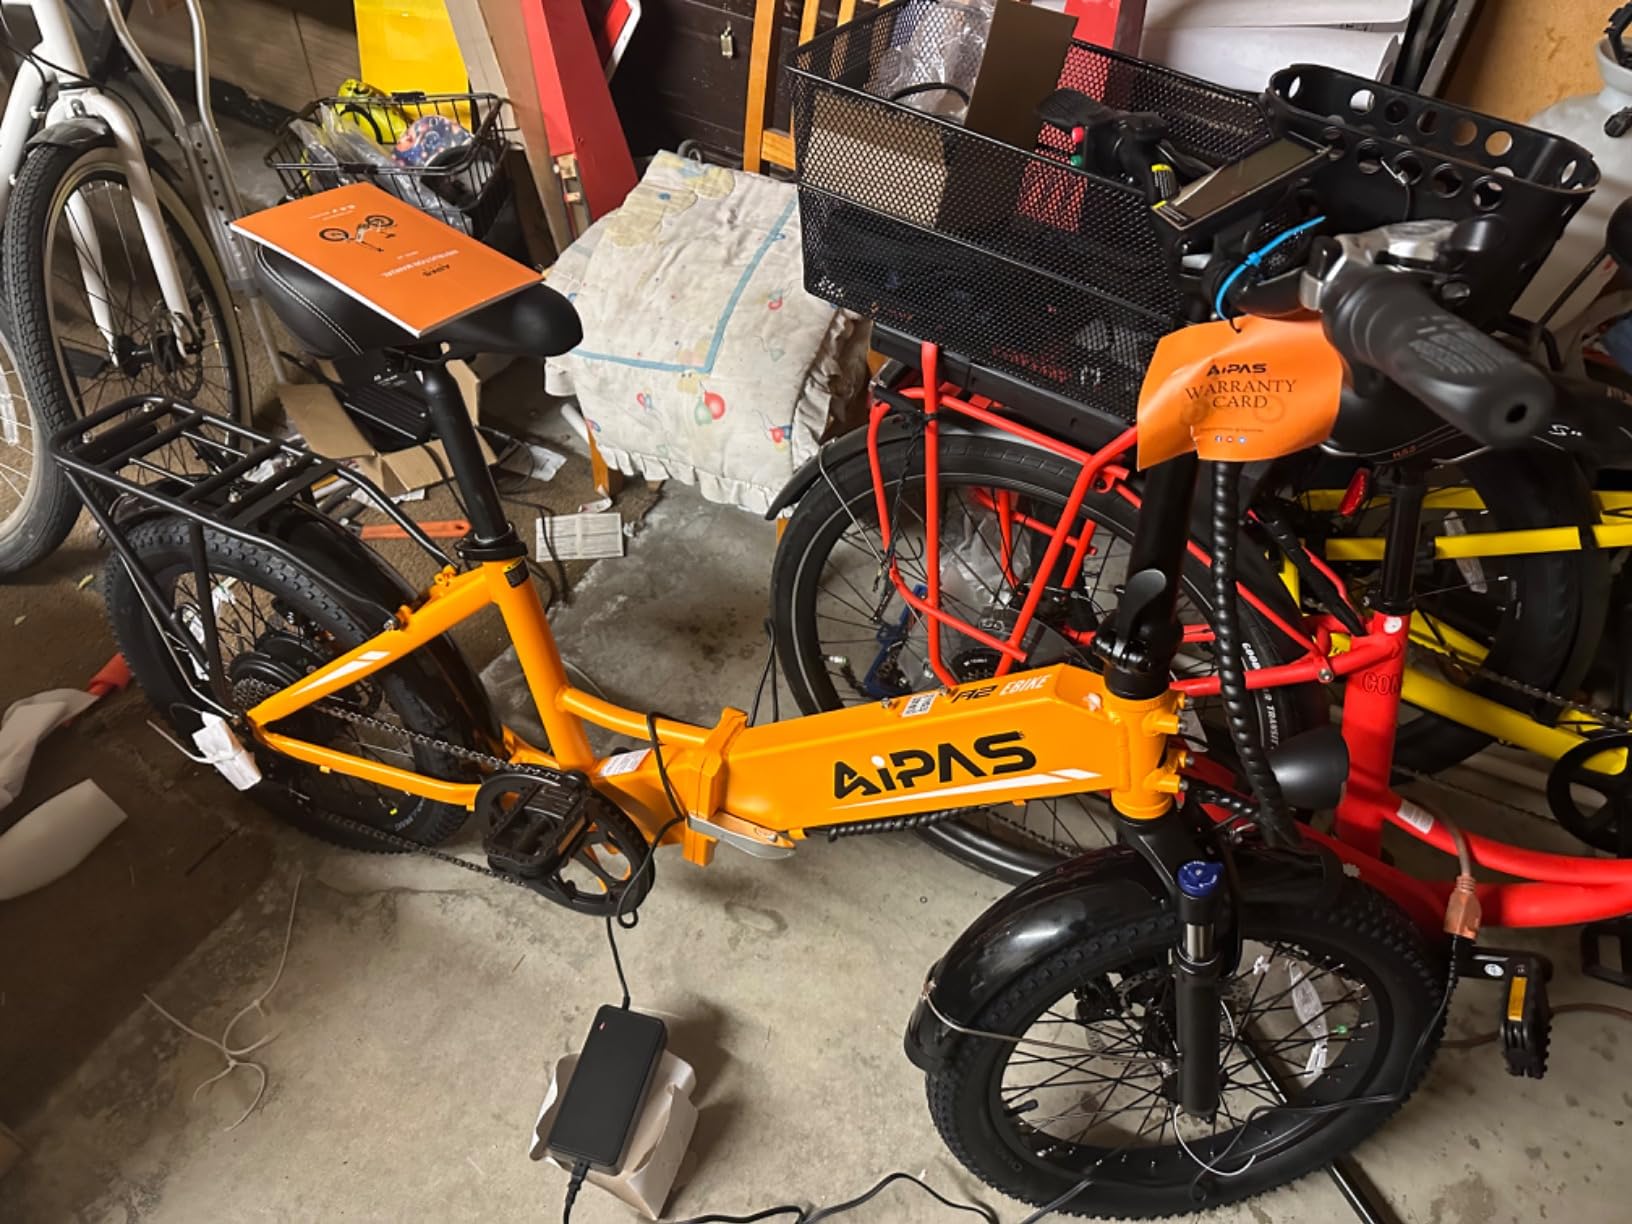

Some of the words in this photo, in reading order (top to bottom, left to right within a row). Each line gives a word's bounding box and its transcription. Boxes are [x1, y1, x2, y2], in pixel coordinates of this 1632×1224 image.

[1184, 379, 1297, 400] WARRANTY
[1212, 395, 1268, 409] CARD
[999, 674, 1053, 696] EBIKE
